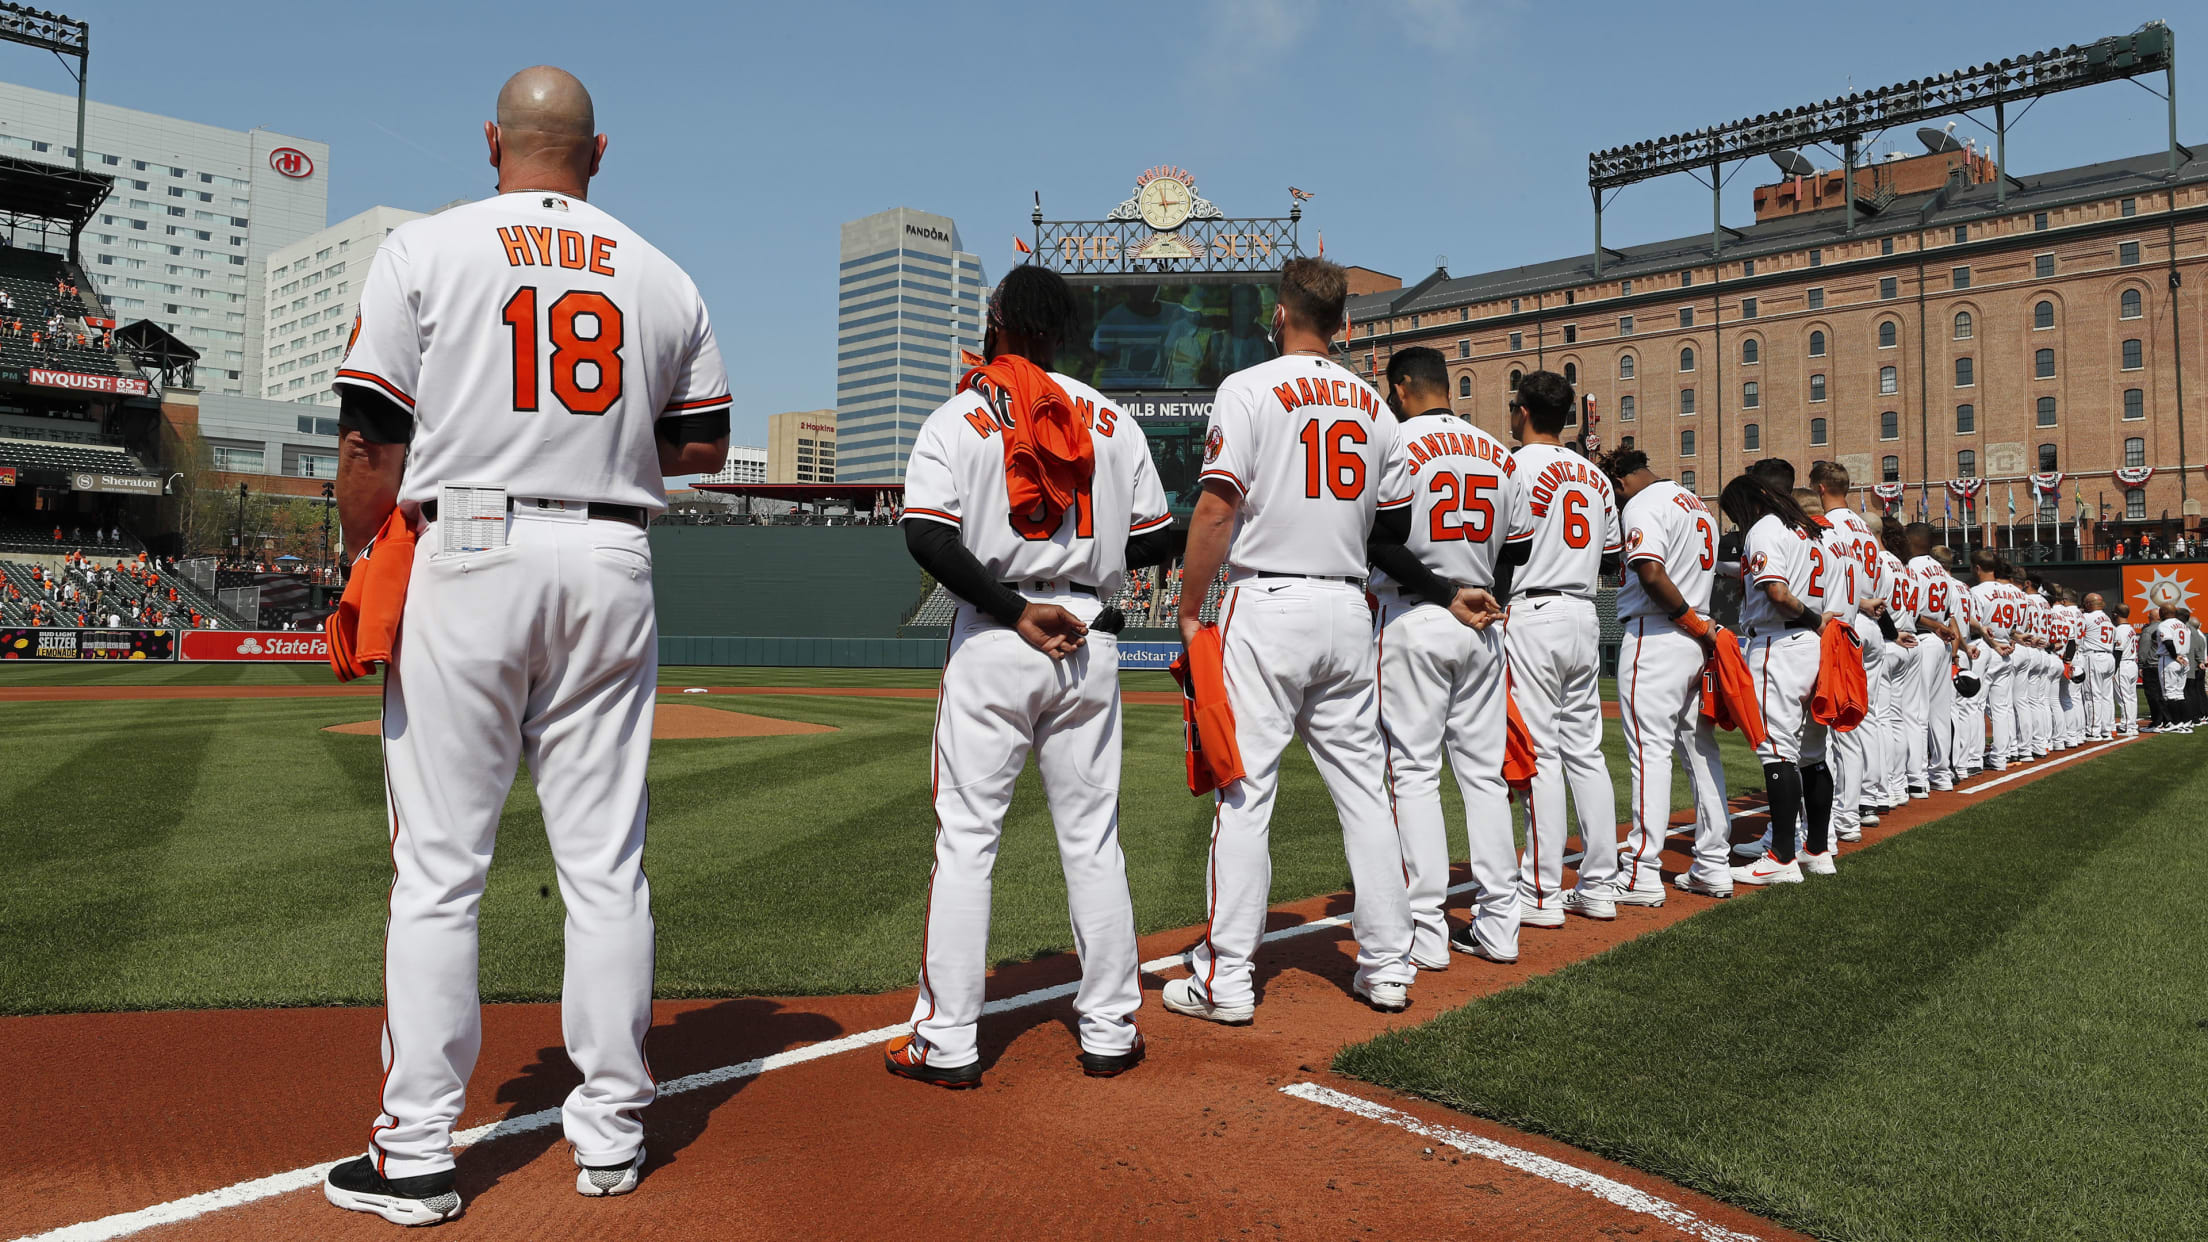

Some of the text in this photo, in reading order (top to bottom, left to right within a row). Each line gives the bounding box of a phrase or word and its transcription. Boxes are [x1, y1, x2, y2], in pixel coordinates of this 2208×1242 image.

[497, 225, 617, 277] HYDE
[1058, 236, 1120, 260] THE
[1213, 234, 1273, 259] SUN
[501, 286, 624, 416] 18
[2, 371, 18, 380] PM
[31, 370, 108, 390] NYQUIST
[115, 377, 135, 389] 65
[1122, 402, 1156, 417] MLB
[1272, 376, 1380, 423] MANCINI
[800, 421, 835, 433] 2 Hopkins
[1300, 418, 1368, 501] 16
[101, 475, 158, 488] Sheraton
[1429, 471, 1499, 545] 25
[1562, 489, 1592, 550] 6
[1696, 517, 1715, 572] 3
[1808, 547, 1825, 599] 2
[1991, 603, 2014, 629] 49
[38, 637, 77, 650] SELTZER
[2178, 629, 2186, 646] 9
[35, 648, 77, 658] LEMONADE
[1118, 650, 1167, 661] MedStar
